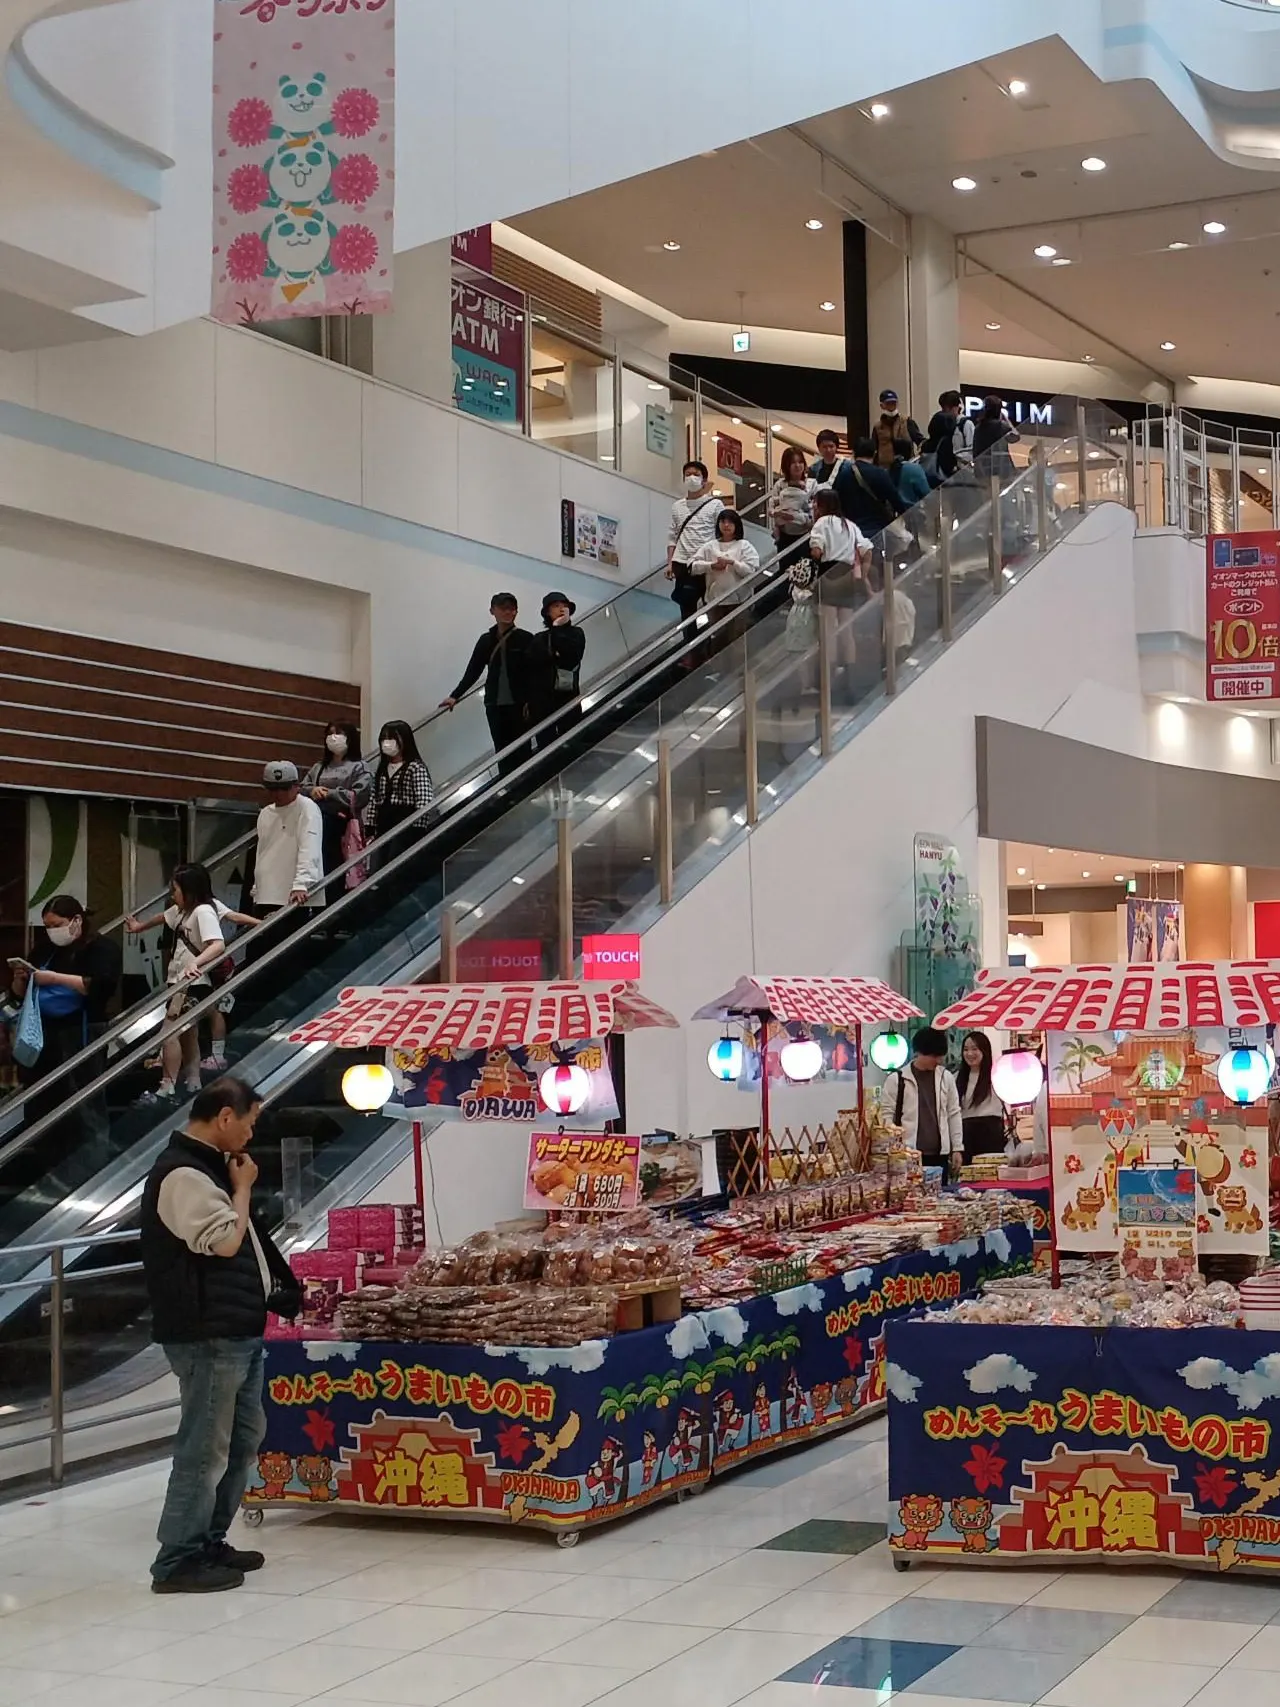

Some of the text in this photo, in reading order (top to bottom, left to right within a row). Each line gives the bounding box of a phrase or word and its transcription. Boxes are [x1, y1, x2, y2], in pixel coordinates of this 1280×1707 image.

[452, 312, 500, 355] ATM
[1228, 601, 1261, 613] ポイント
[1221, 678, 1266, 697] 開催中
[595, 951, 640, 964] TOUCH
[377, 1360, 556, 1422] うまいもの市
[1060, 1388, 1272, 1462] うまいもの市
[372, 1447, 470, 1507] 沖縄
[500, 1471, 580, 1501] OKINAWA
[1046, 1486, 1160, 1552] 沖縄
